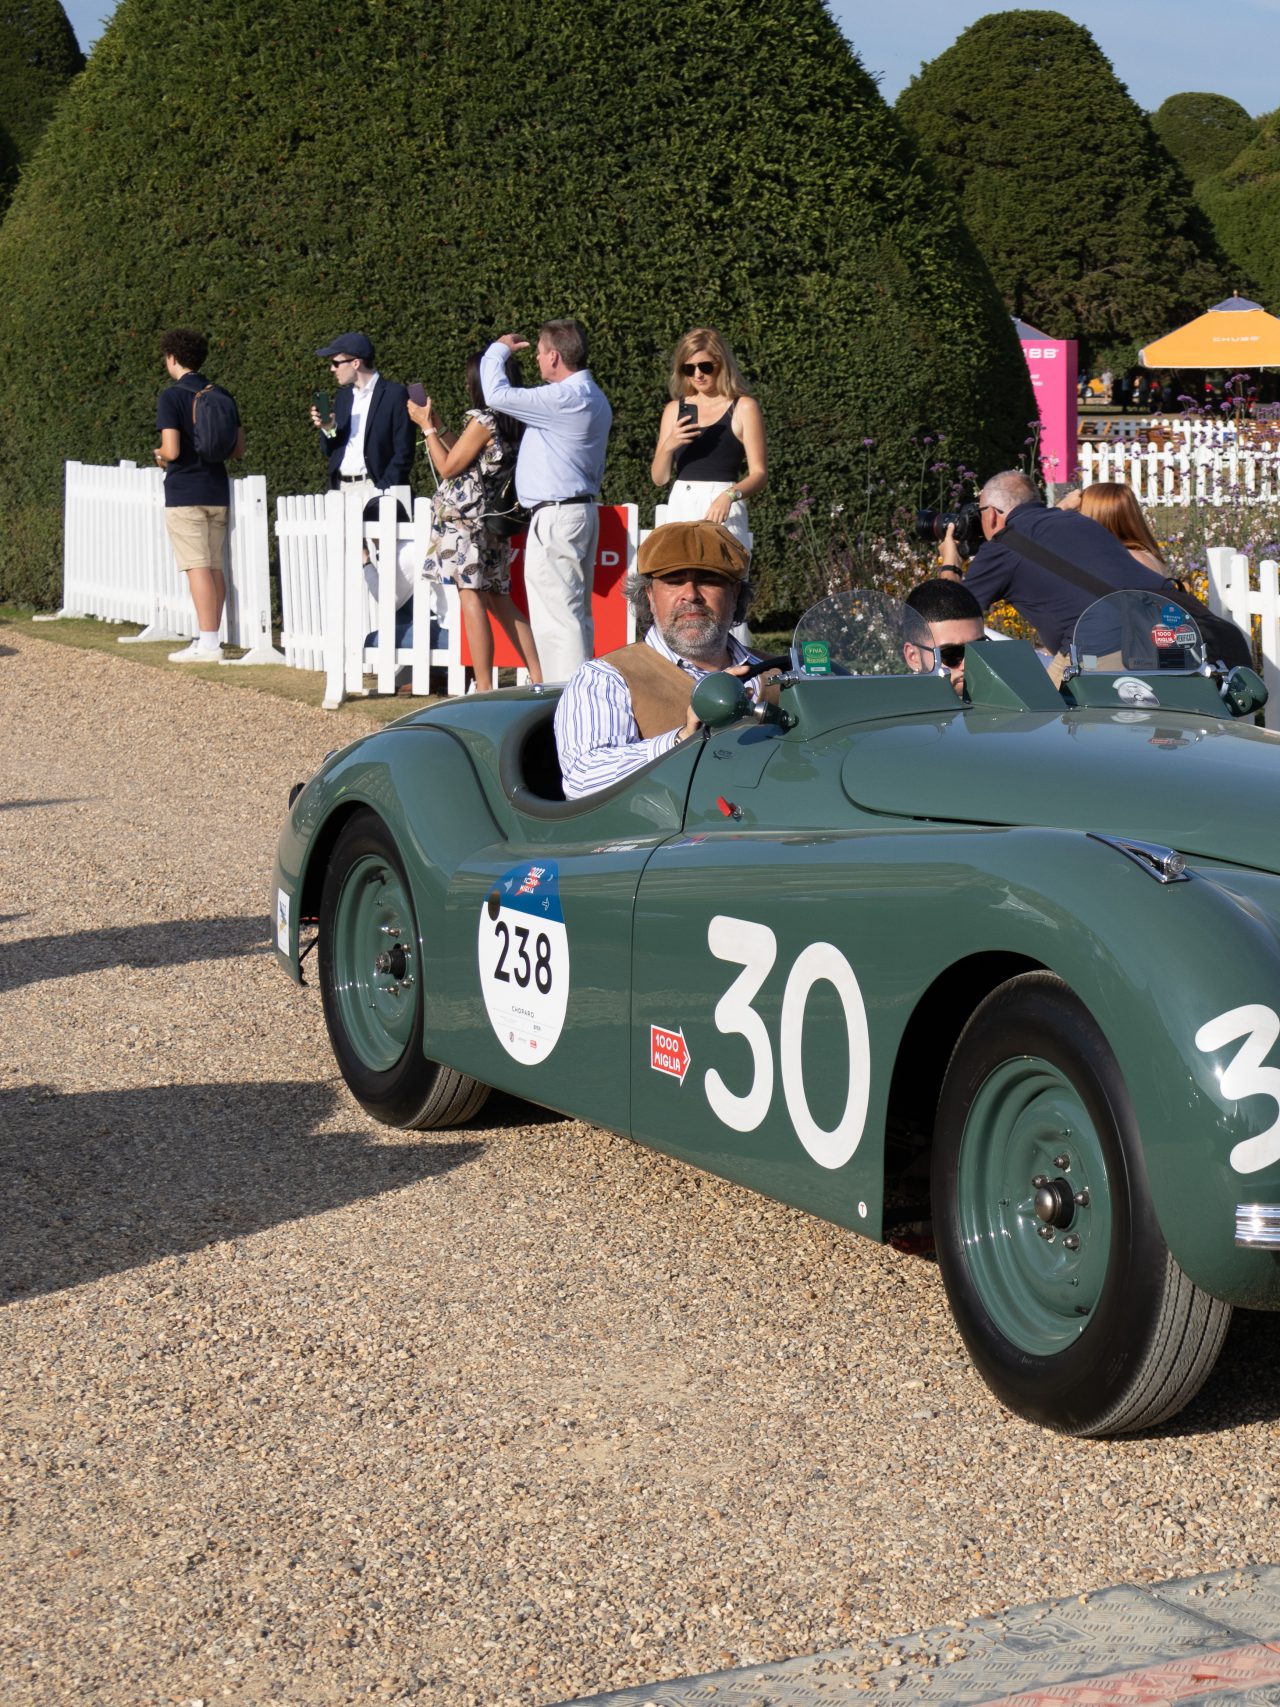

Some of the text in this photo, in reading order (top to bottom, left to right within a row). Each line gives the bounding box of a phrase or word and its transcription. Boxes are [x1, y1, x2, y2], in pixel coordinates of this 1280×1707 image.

[1212, 335, 1260, 343] CHUBB
[494, 920, 553, 995] 238
[655, 1033, 679, 1053] 1000
[704, 915, 871, 1170] 30
[654, 1051, 681, 1072] MIGLIA
